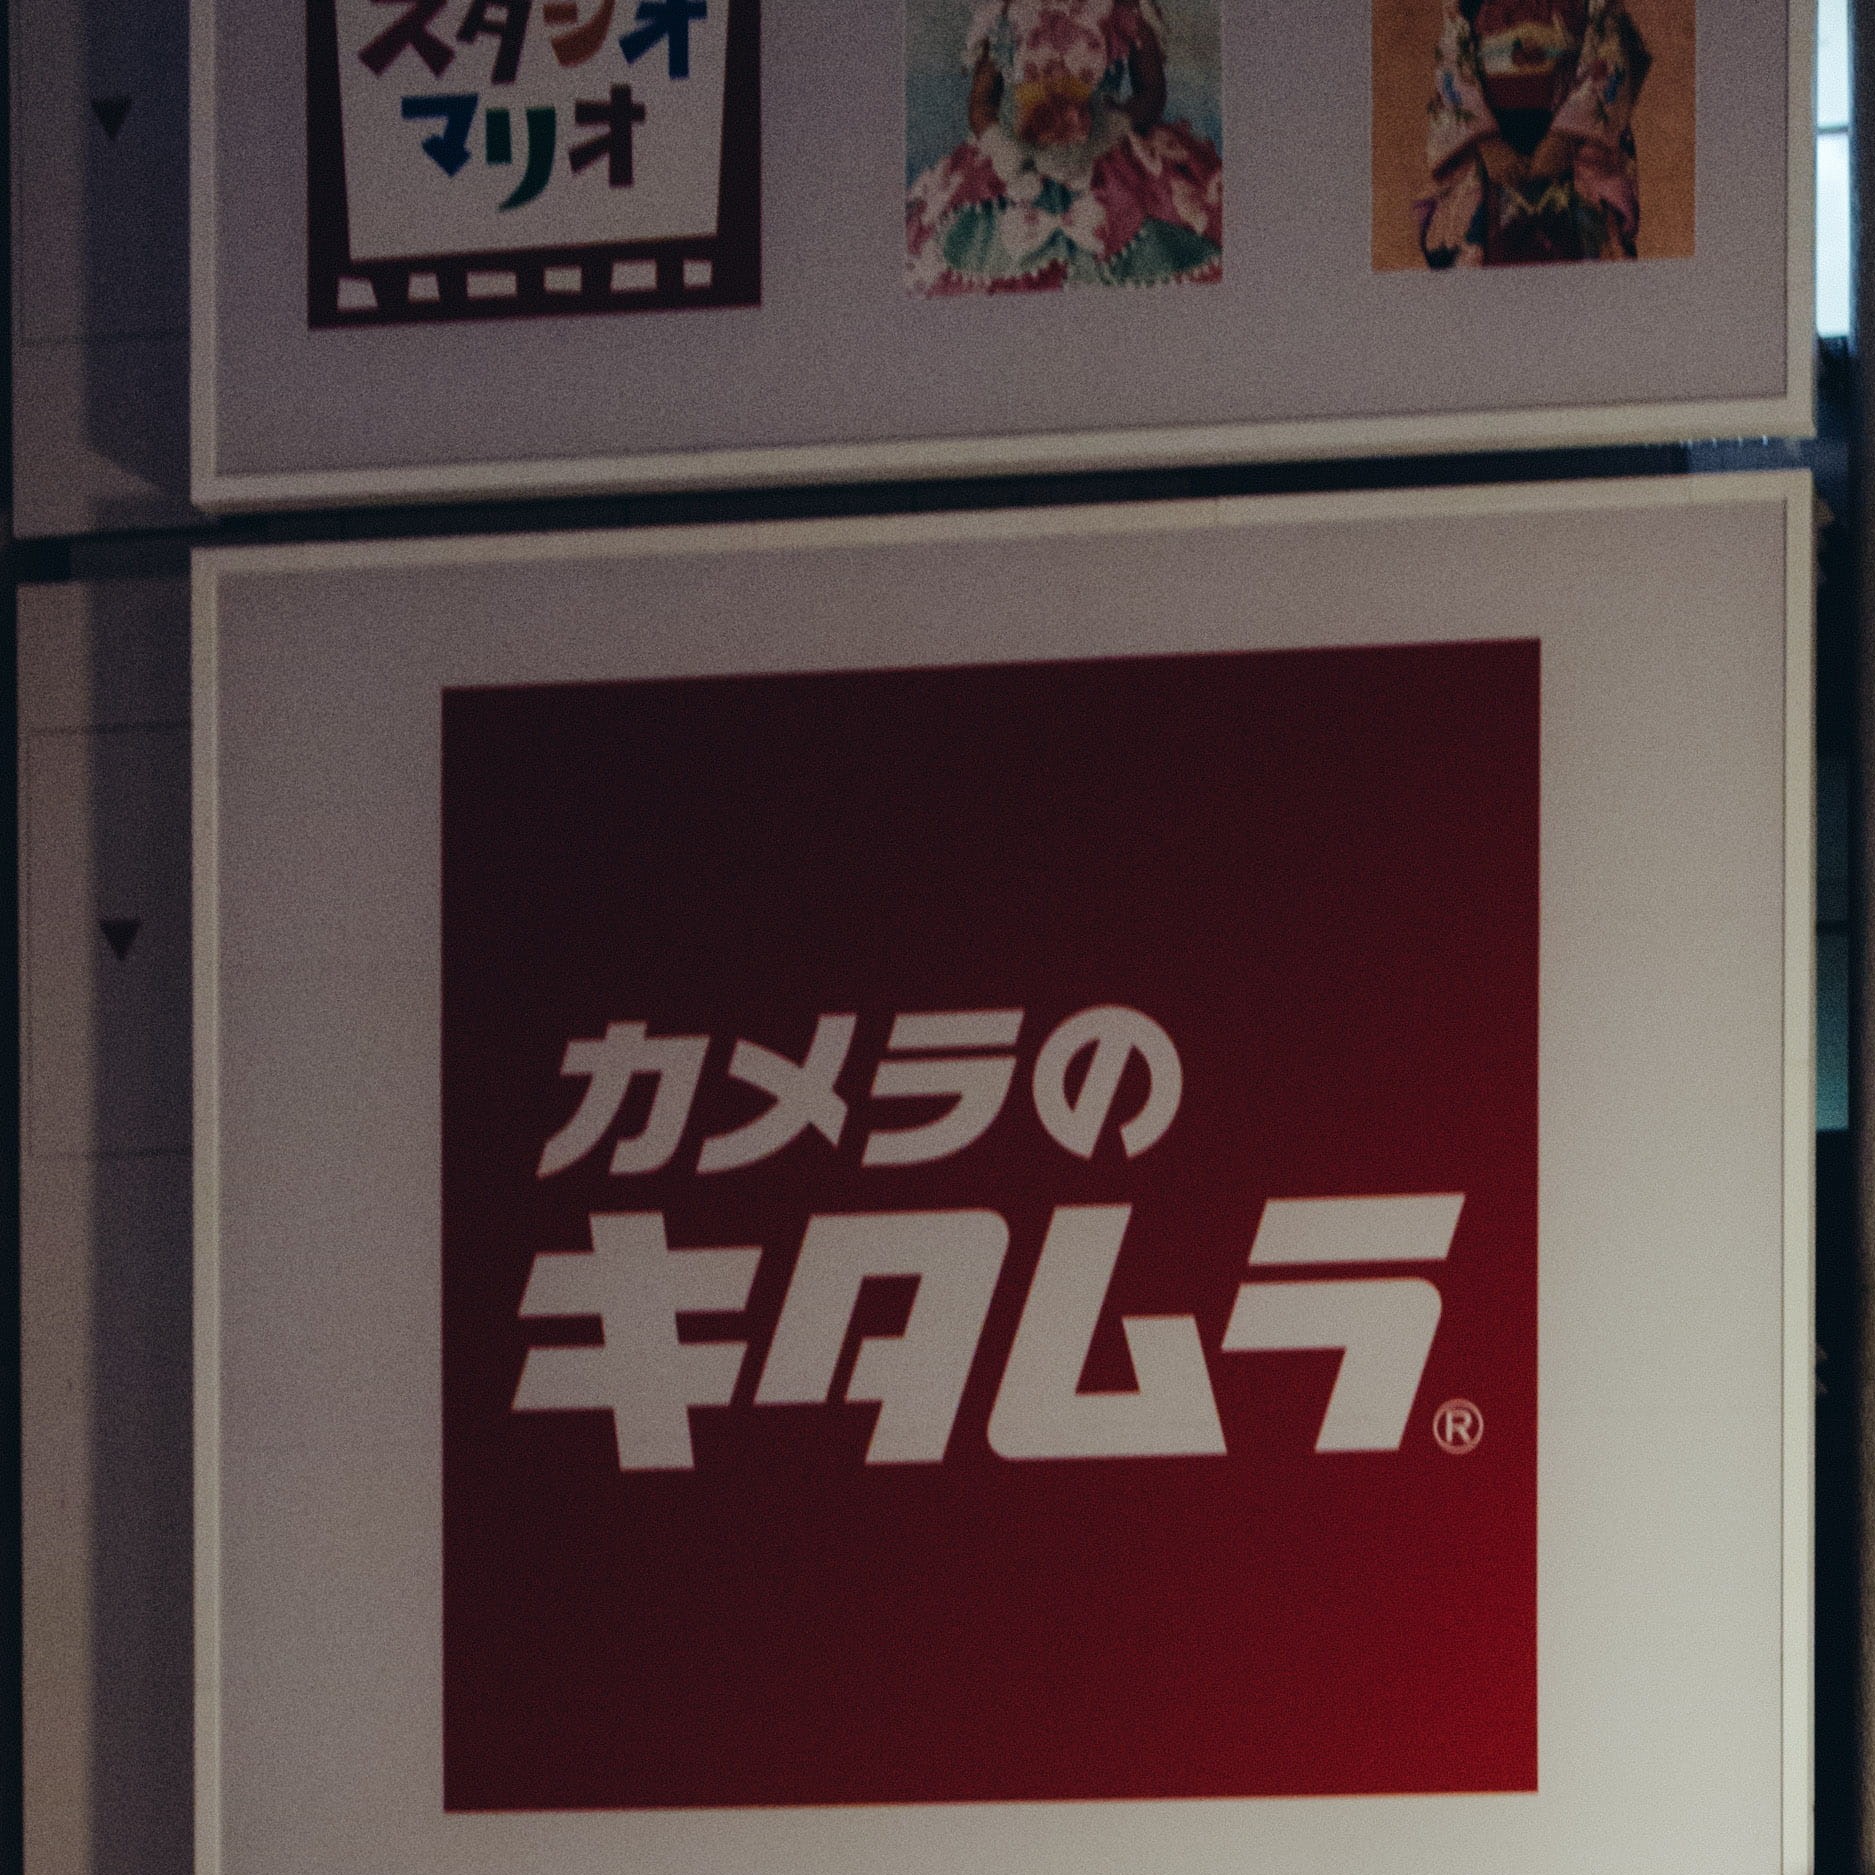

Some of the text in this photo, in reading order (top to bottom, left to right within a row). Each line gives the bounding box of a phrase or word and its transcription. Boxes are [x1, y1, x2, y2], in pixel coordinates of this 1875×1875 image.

[401, 83, 647, 213] マリオ
[537, 1003, 1184, 1179] カメラの
[511, 1192, 1466, 1471] キタムラ
